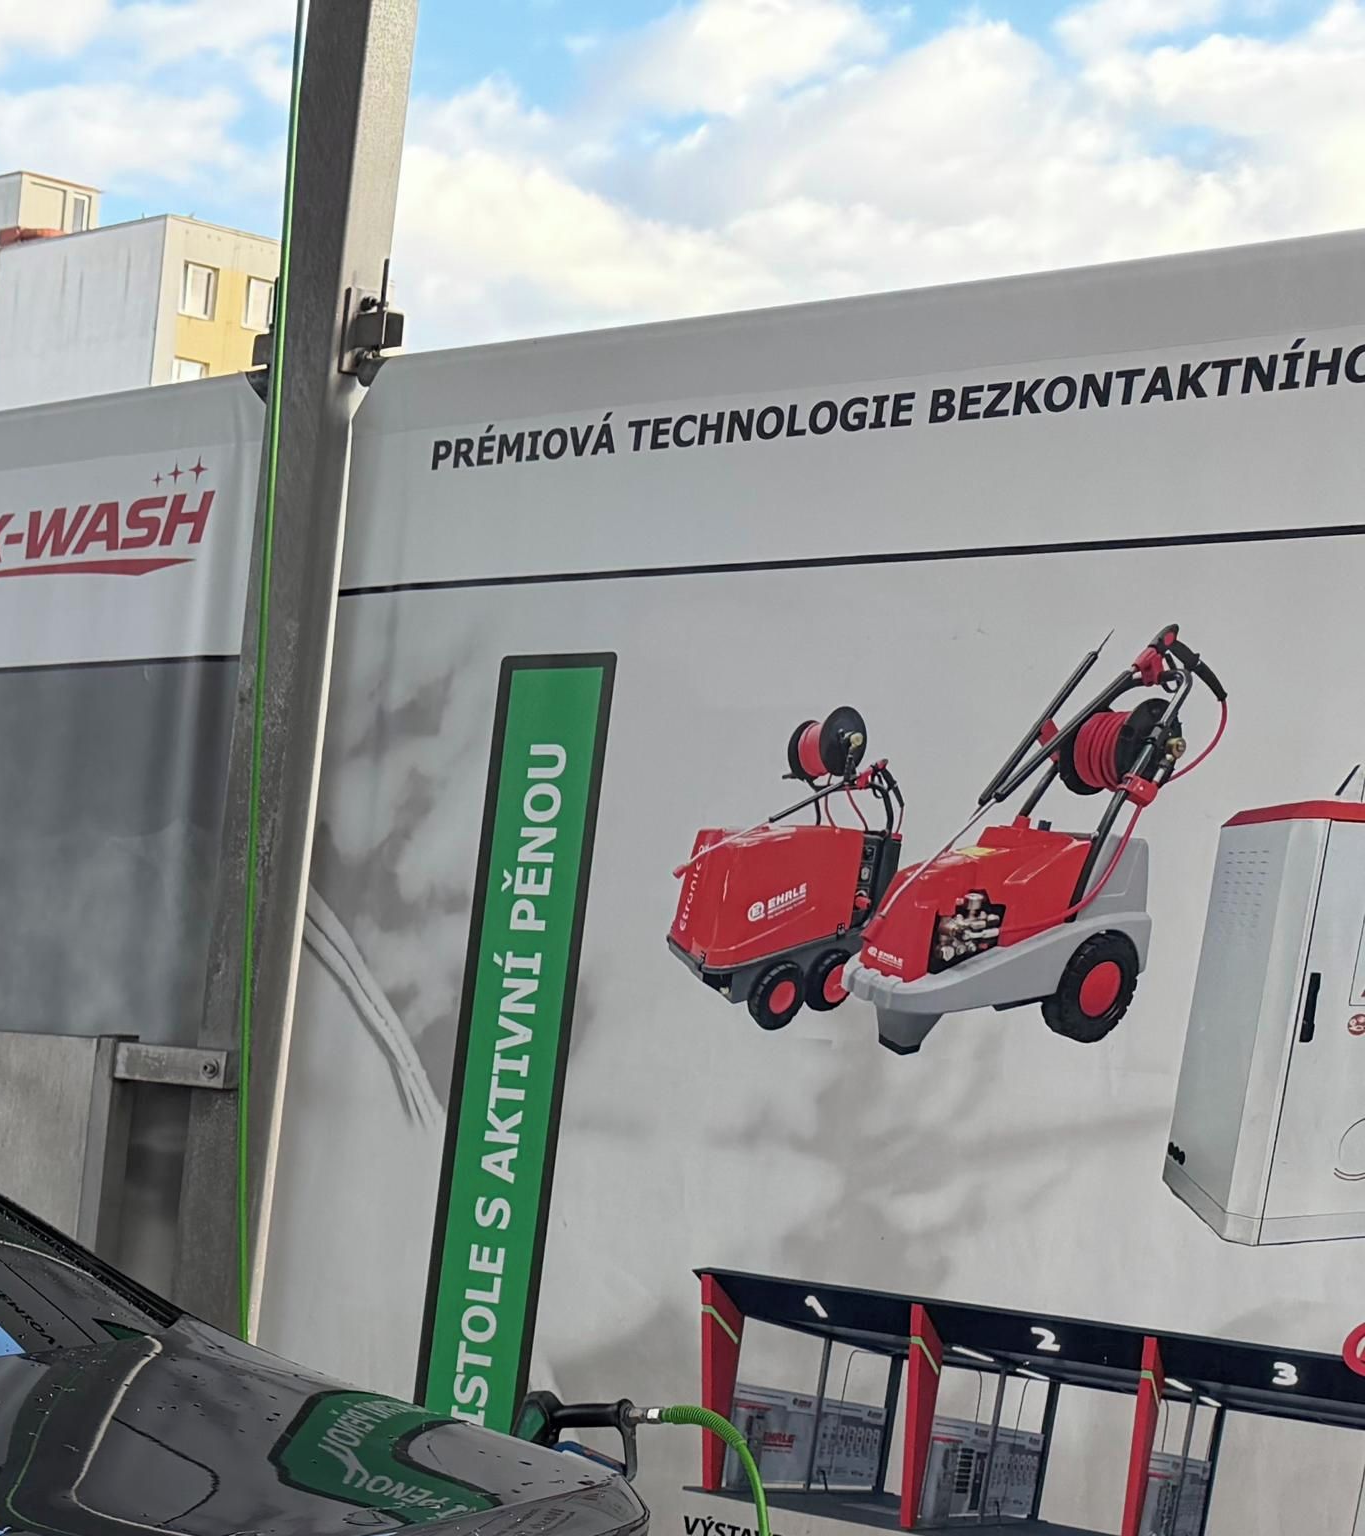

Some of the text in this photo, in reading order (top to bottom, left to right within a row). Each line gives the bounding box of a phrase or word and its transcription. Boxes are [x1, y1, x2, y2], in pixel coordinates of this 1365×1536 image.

[431, 337, 1365, 471] PRÉMIOVÁ TECHNOLOGIE BEZKONTAKTNÍHO
[767, 882, 807, 910] EHRLE
[450, 743, 567, 1427] ISTOLE S AKTIVNÍ PĚNOU
[804, 1295, 829, 1318] 1
[1030, 1326, 1062, 1352] 2
[1272, 1361, 1299, 1387] 3
